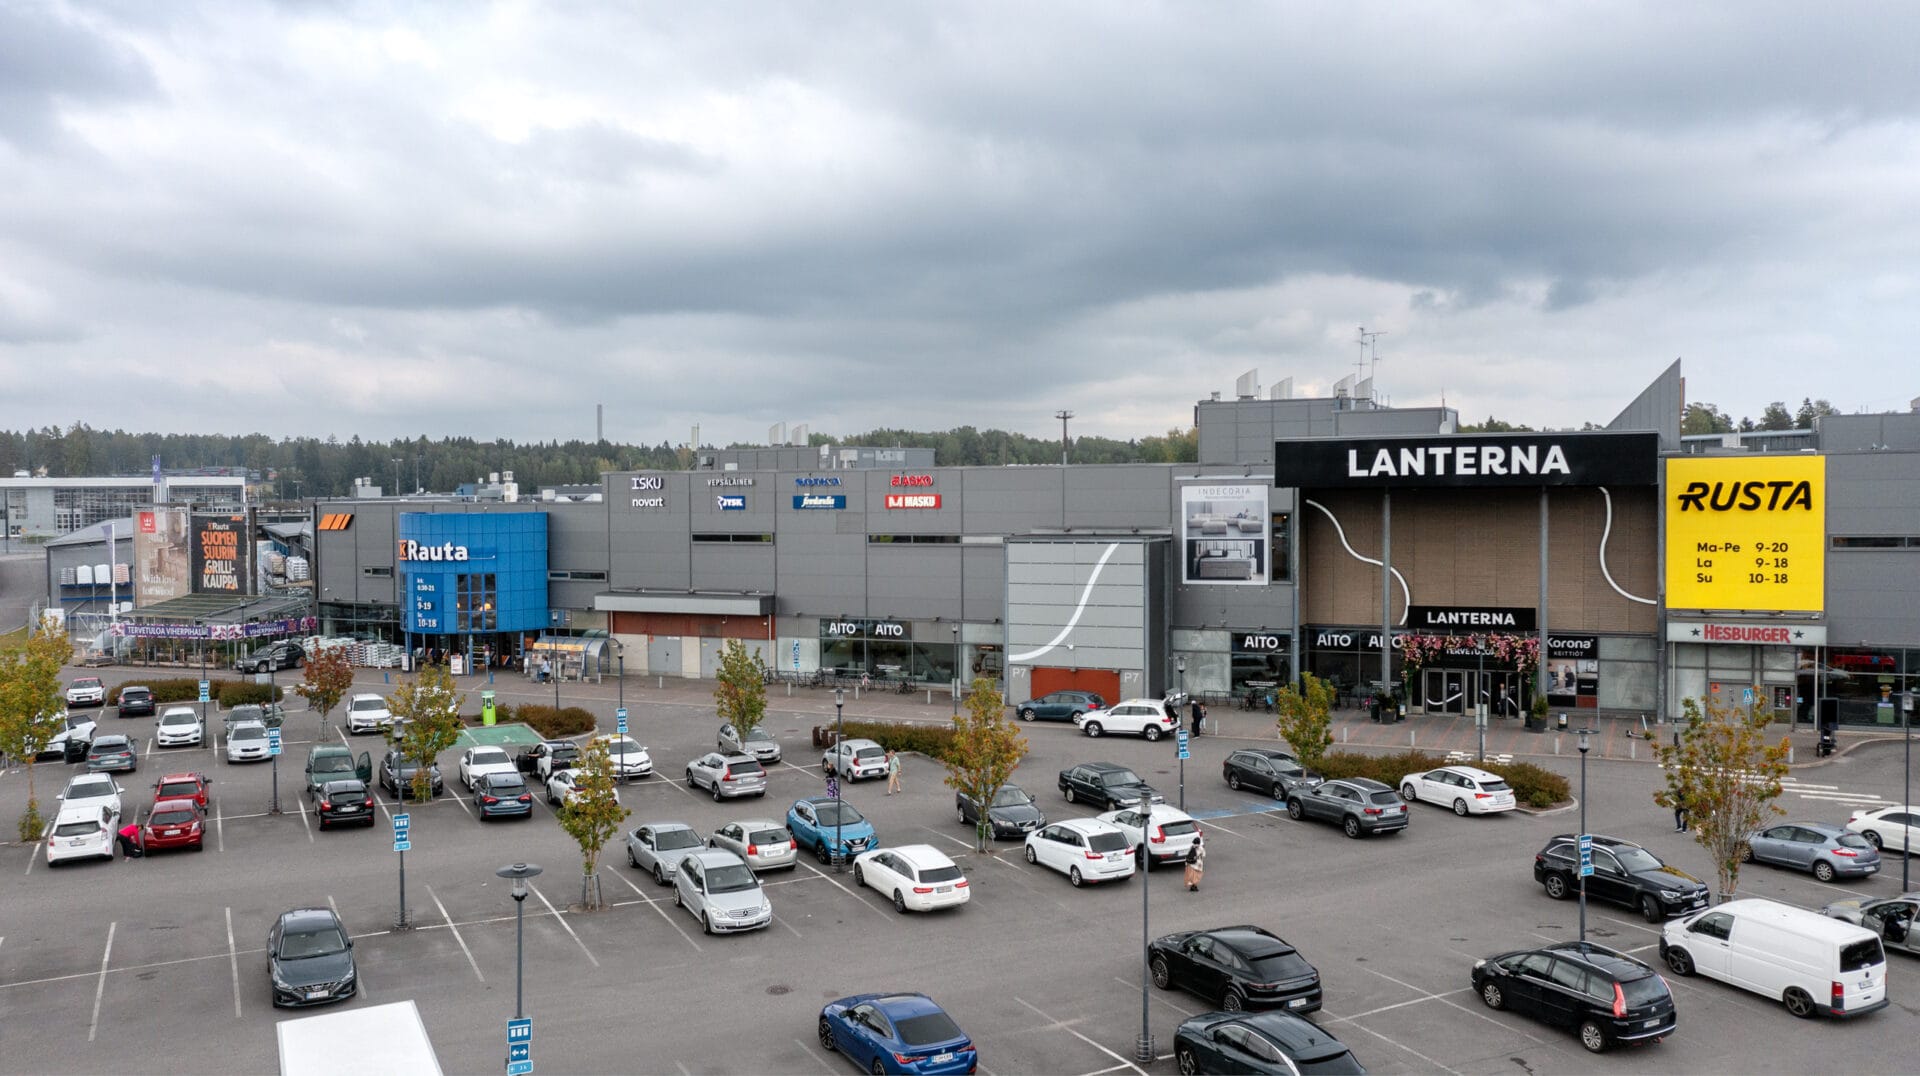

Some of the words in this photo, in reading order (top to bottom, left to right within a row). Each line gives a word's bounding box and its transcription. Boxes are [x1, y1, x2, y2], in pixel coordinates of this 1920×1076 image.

[1348, 445, 1571, 477] LANTERNA
[632, 477, 662, 490] ISKU
[632, 497, 663, 507] novart
[905, 496, 936, 507] MASKU
[1678, 481, 1812, 511] RUSTA
[201, 532, 238, 545] SUOMEN
[203, 546, 236, 560] SUURIN
[1697, 542, 1740, 553] Ma-Pe
[1755, 542, 1789, 553] 9-20
[205, 560, 235, 574] GRILLI-
[1697, 558, 1712, 568] La
[203, 575, 238, 589] KAUPPA
[1697, 573, 1712, 583] Su
[1427, 611, 1516, 625] LANTERNA
[127, 626, 166, 635] TERVETULOA
[828, 622, 856, 634] AITO
[875, 624, 903, 636] AITO
[1703, 624, 1791, 643] HESBURGER
[1244, 635, 1278, 648] AITO
[1317, 634, 1351, 647] AITO
[1012, 667, 1026, 678] P7
[1124, 672, 1139, 683] P7
